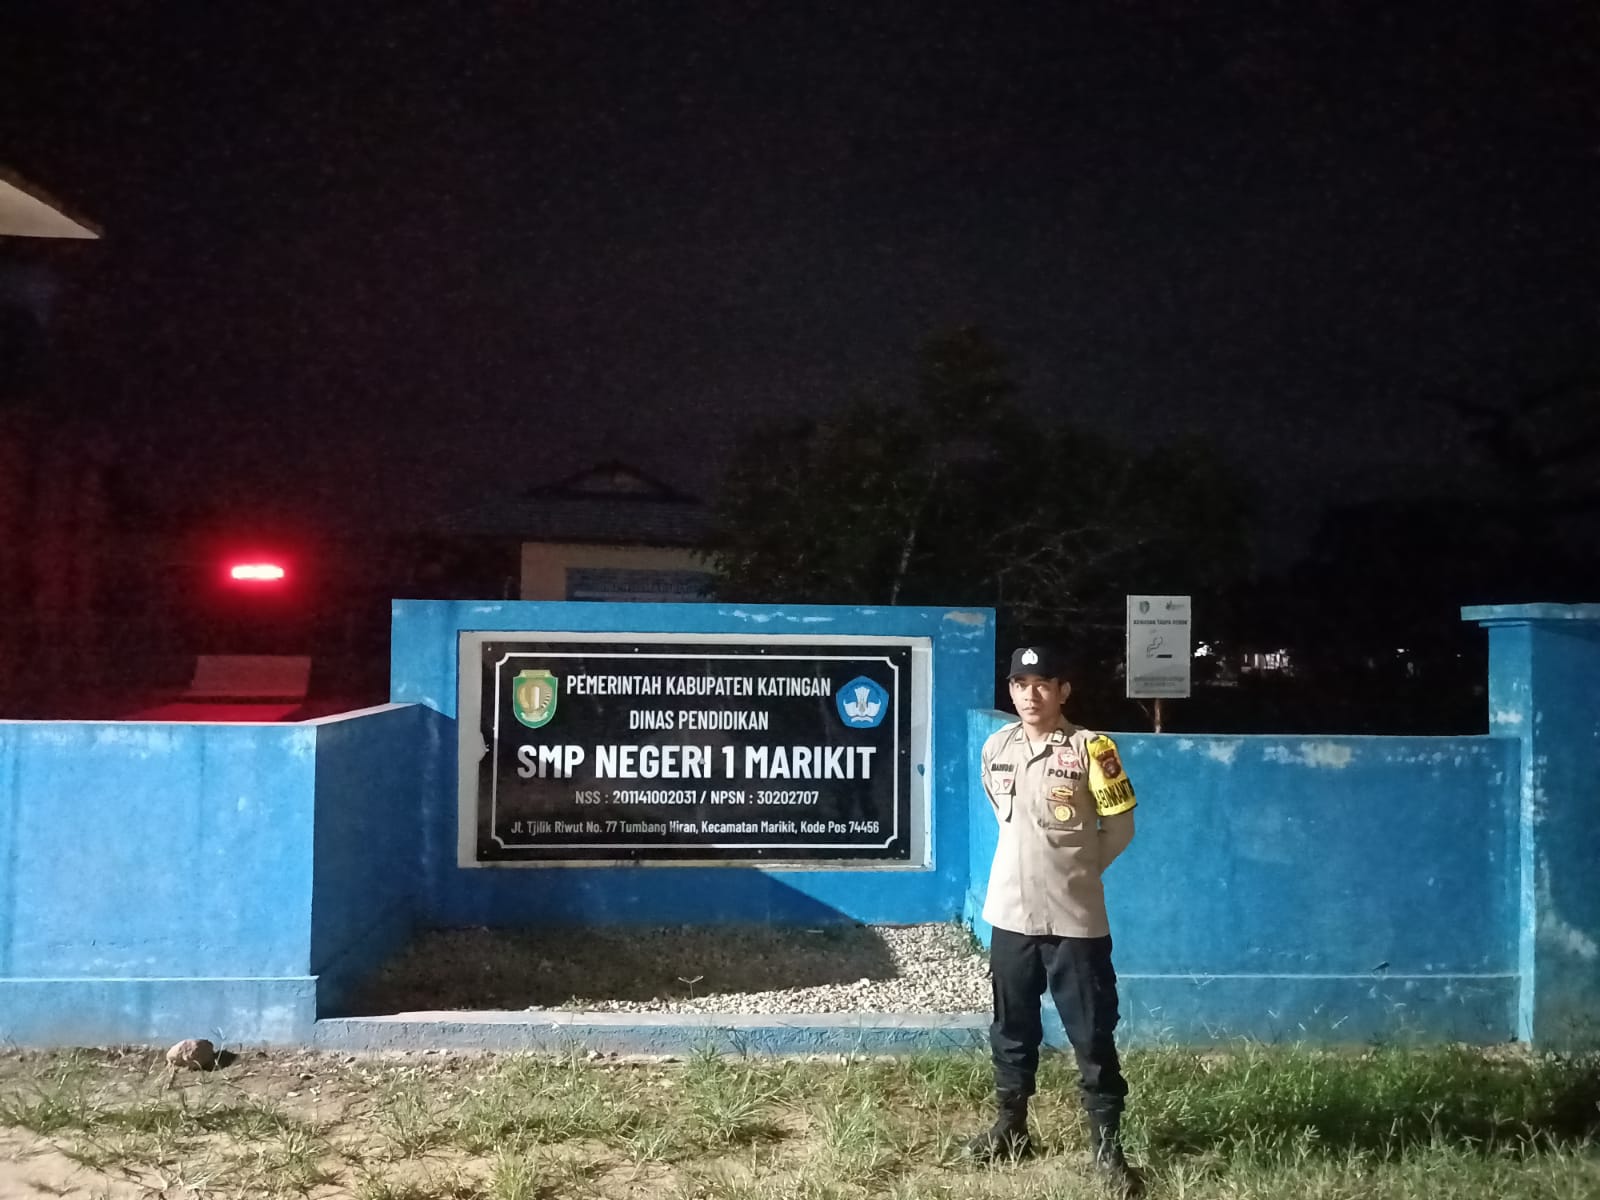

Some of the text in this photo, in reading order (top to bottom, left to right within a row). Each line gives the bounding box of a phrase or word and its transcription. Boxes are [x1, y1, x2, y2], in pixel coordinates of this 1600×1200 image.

[566, 675, 831, 697] PEMERINTAH KABUPATEN KATINGAN
[629, 710, 769, 731] DINAS PENDIDIKAN
[517, 744, 877, 780] SMP NEGERI 1 MARIKIT
[575, 790, 601, 804] NSS
[612, 790, 697, 805] 201141002031
[710, 790, 746, 805] NPSN
[757, 790, 820, 805] 30202707
[511, 821, 524, 834] Jl.
[527, 820, 551, 836] Tjilik
[554, 820, 584, 833] Riwut
[586, 820, 603, 833] No.
[605, 820, 618, 833] 77
[620, 820, 667, 836] Tumbang
[669, 820, 699, 835] Hiran,
[701, 820, 759, 834] Kecamatan
[760, 820, 798, 835] Marikit,
[800, 820, 826, 834] Kode
[827, 820, 847, 834] Pos
